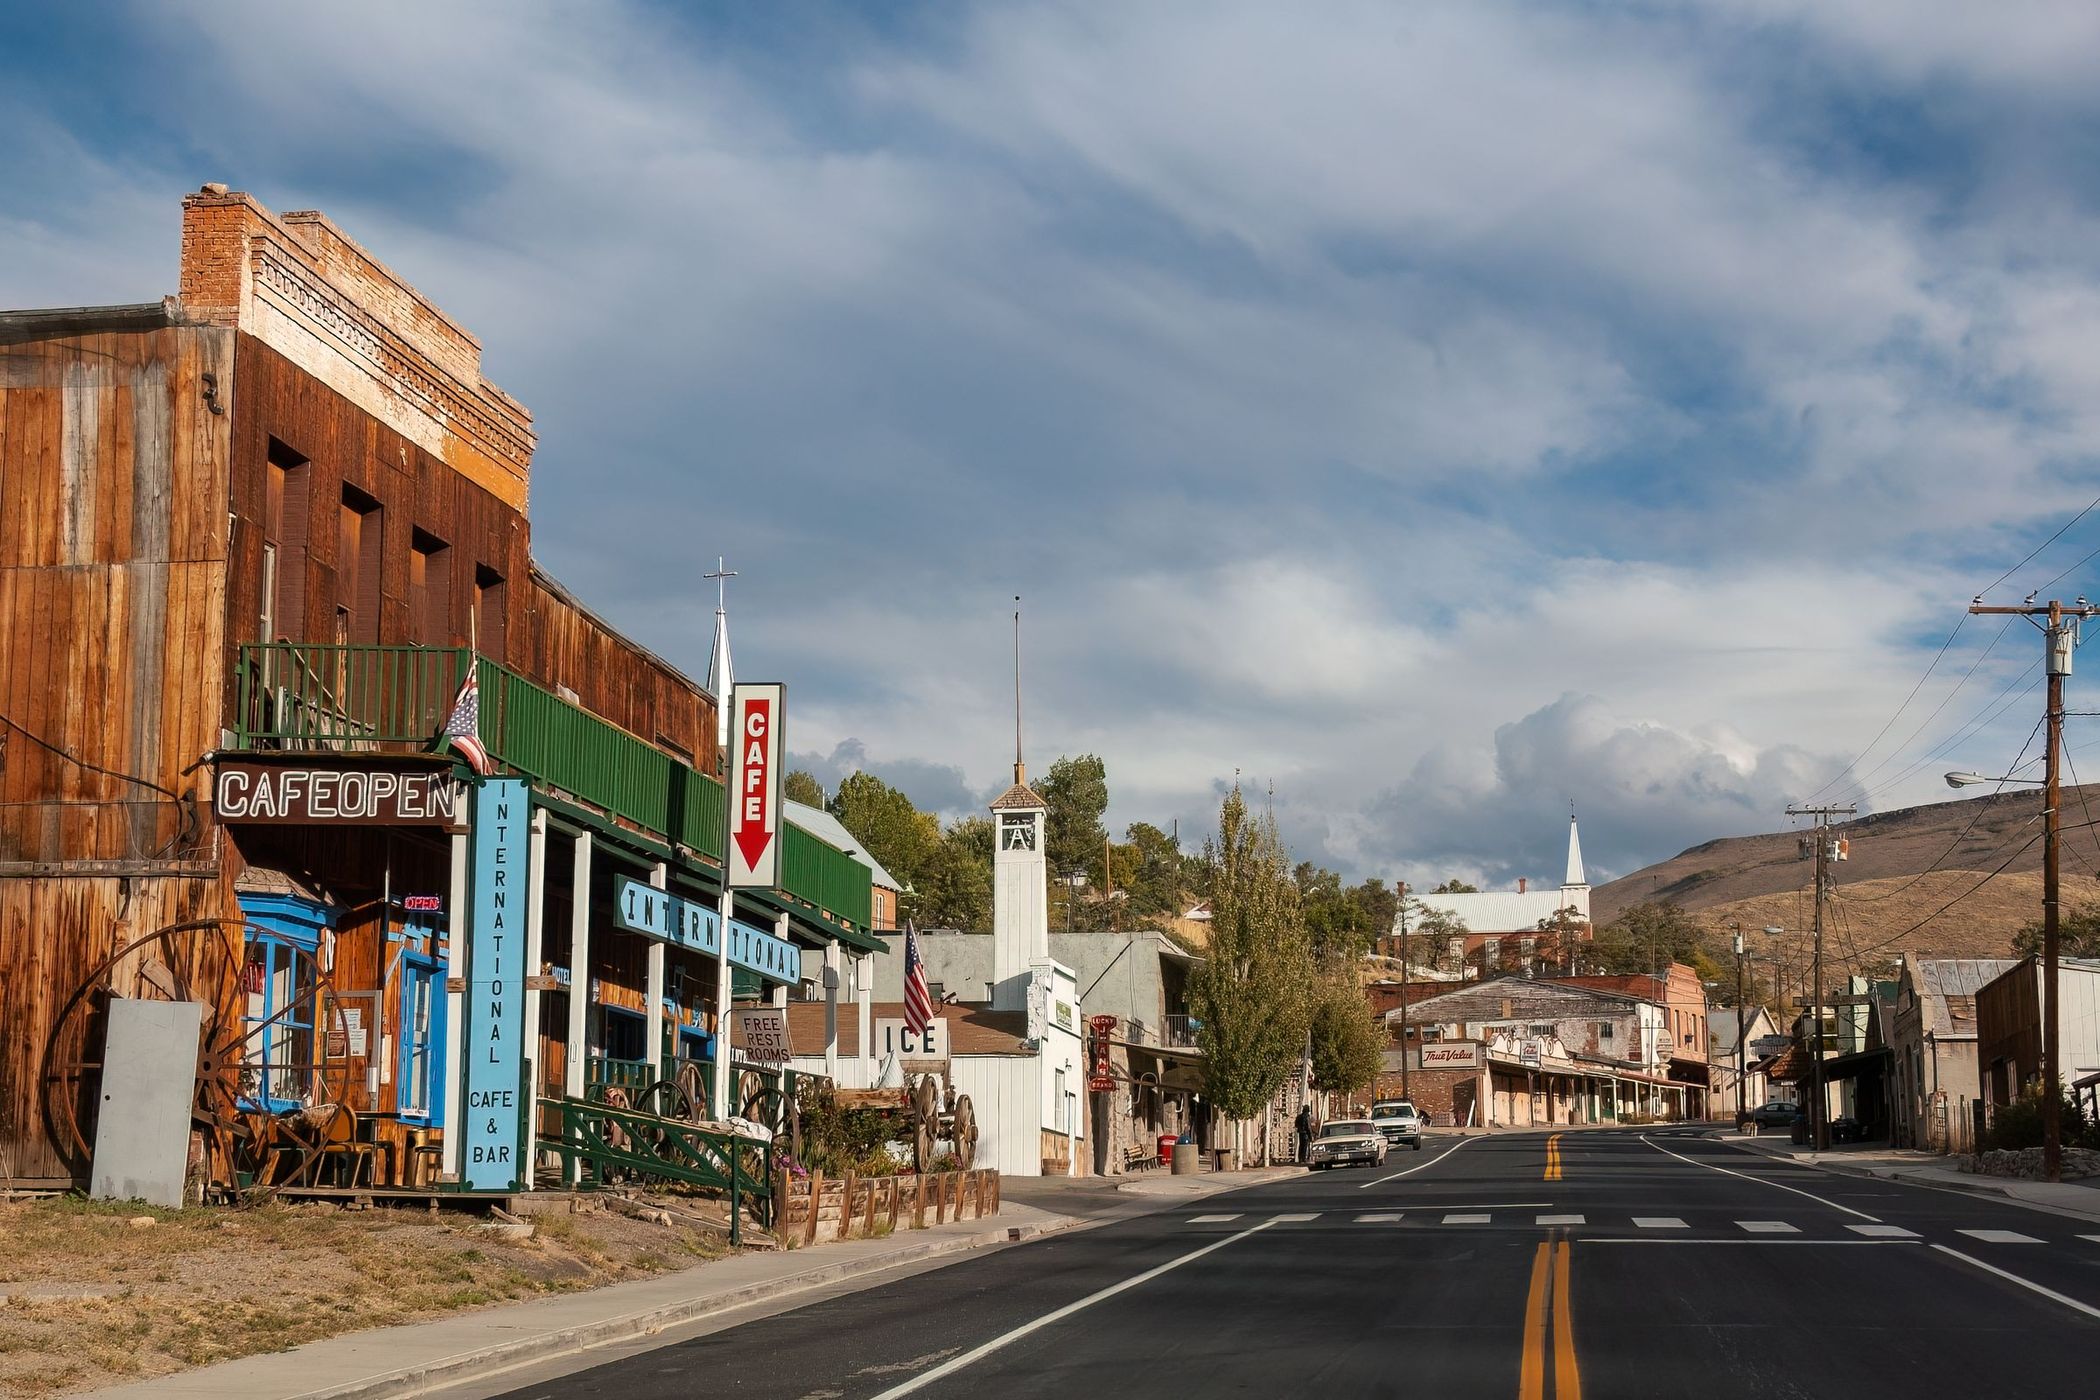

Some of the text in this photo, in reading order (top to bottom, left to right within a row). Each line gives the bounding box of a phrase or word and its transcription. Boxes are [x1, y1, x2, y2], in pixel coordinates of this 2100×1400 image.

[746, 712, 766, 821] CAFE
[407, 899, 437, 909] OPEN
[490, 782, 508, 1064] INTERNATIONAL
[628, 889, 796, 979] INTERNTIONAL
[744, 1017, 781, 1031] FREE
[747, 1033, 782, 1047] REST
[886, 1025, 936, 1054] ICE
[746, 1047, 790, 1061] ROOMS
[470, 1091, 513, 1108] CAFE
[486, 1117, 498, 1135] &
[473, 1146, 510, 1163] BAR
